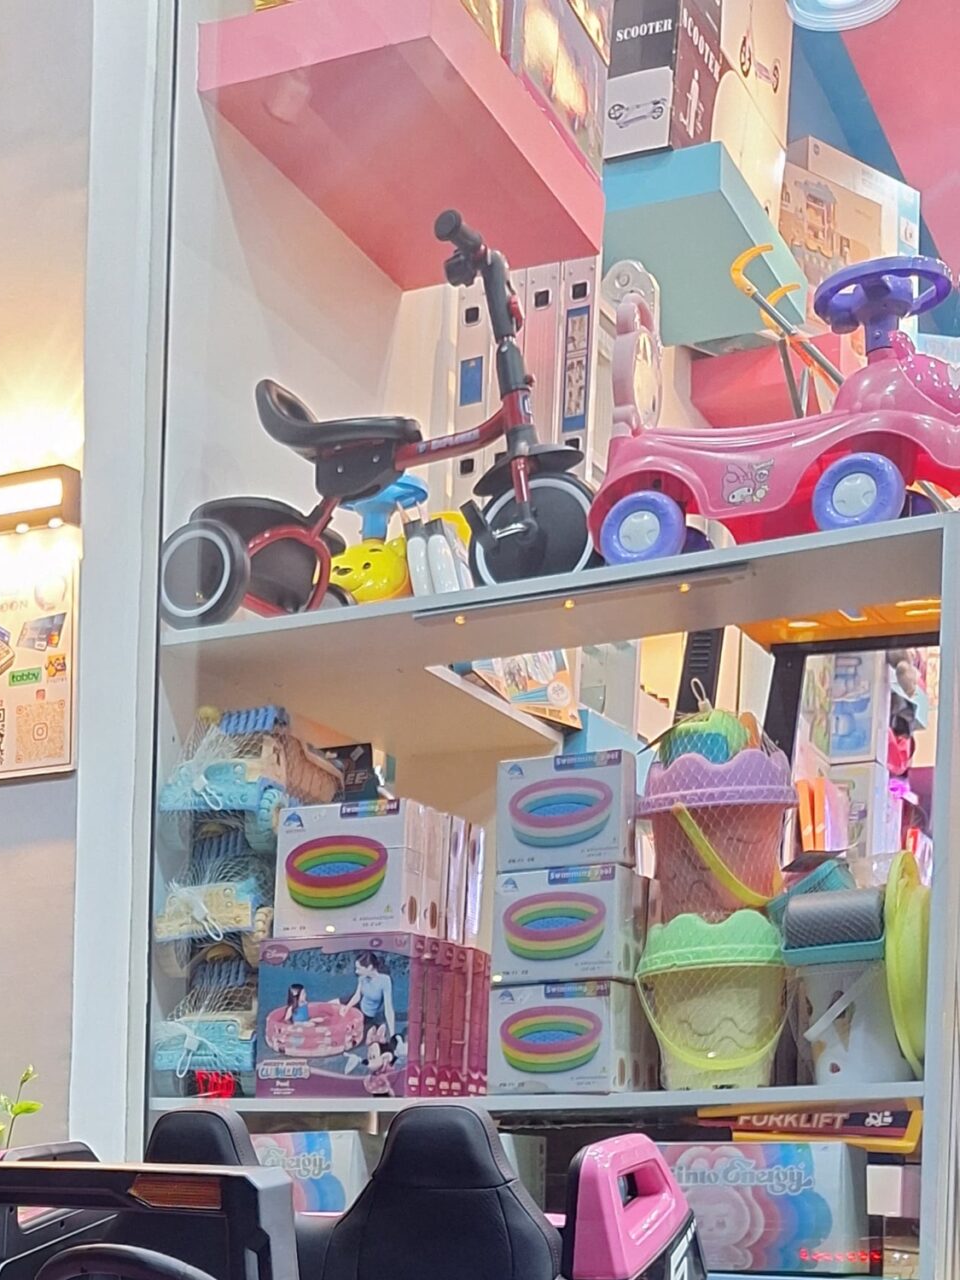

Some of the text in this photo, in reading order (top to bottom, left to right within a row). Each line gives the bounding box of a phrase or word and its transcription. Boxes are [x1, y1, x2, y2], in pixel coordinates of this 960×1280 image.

[615, 18, 672, 42] SCOOTER
[683, 8, 721, 82] SCOOTER
[12, 671, 40, 684] tabby
[738, 1111, 850, 1130] FORKLIFT
[722, 1157, 814, 1195] Energy
